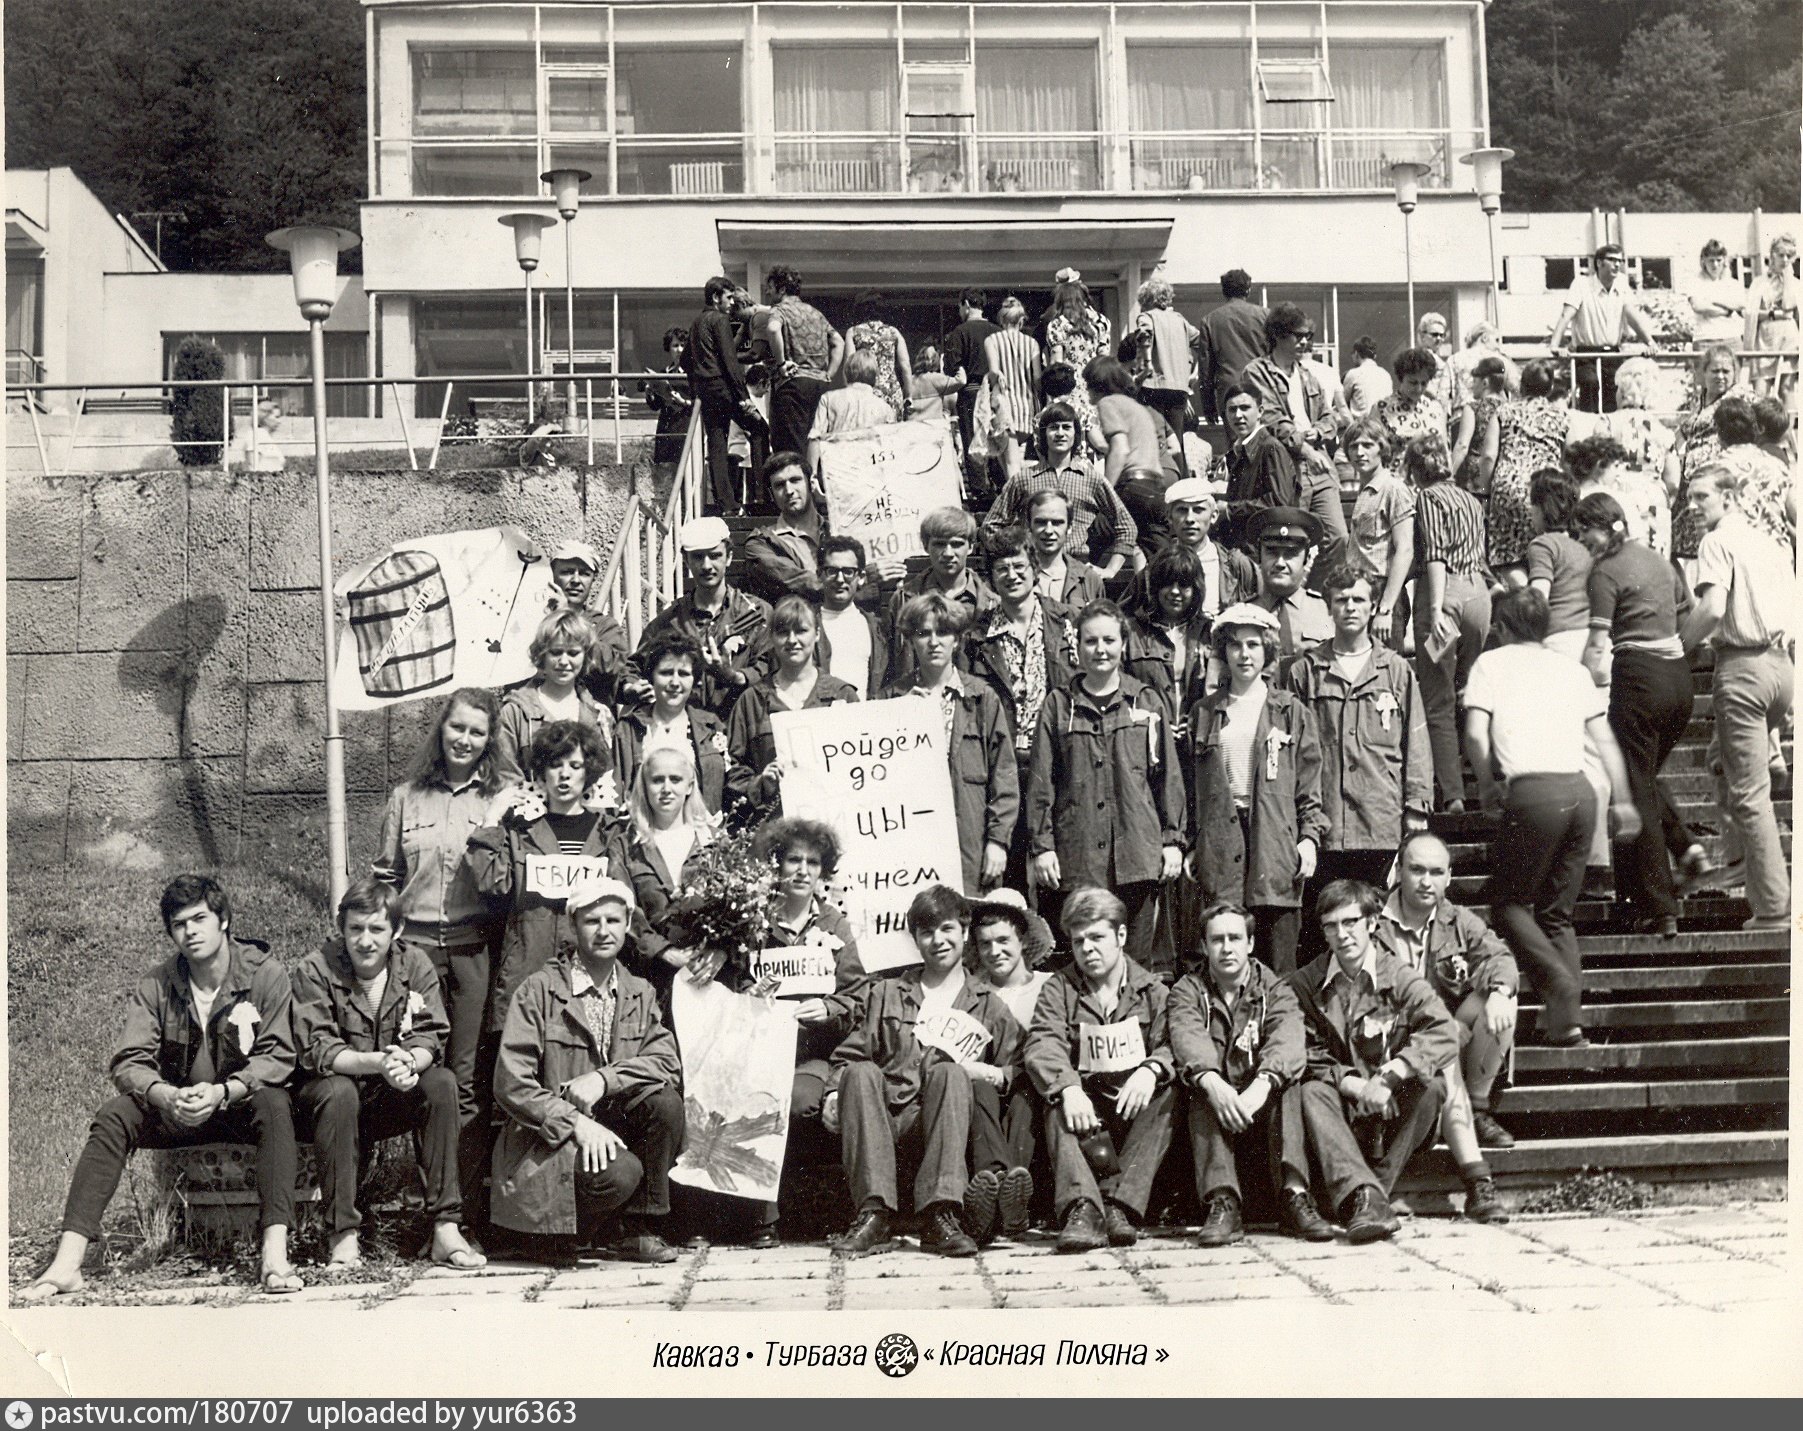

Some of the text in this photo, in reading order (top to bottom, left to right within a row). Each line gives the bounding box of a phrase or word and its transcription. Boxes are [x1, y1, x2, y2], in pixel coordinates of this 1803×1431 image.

[875, 493, 895, 510] НЕ
[869, 531, 922, 560] КОЛ
[850, 763, 887, 791] до
